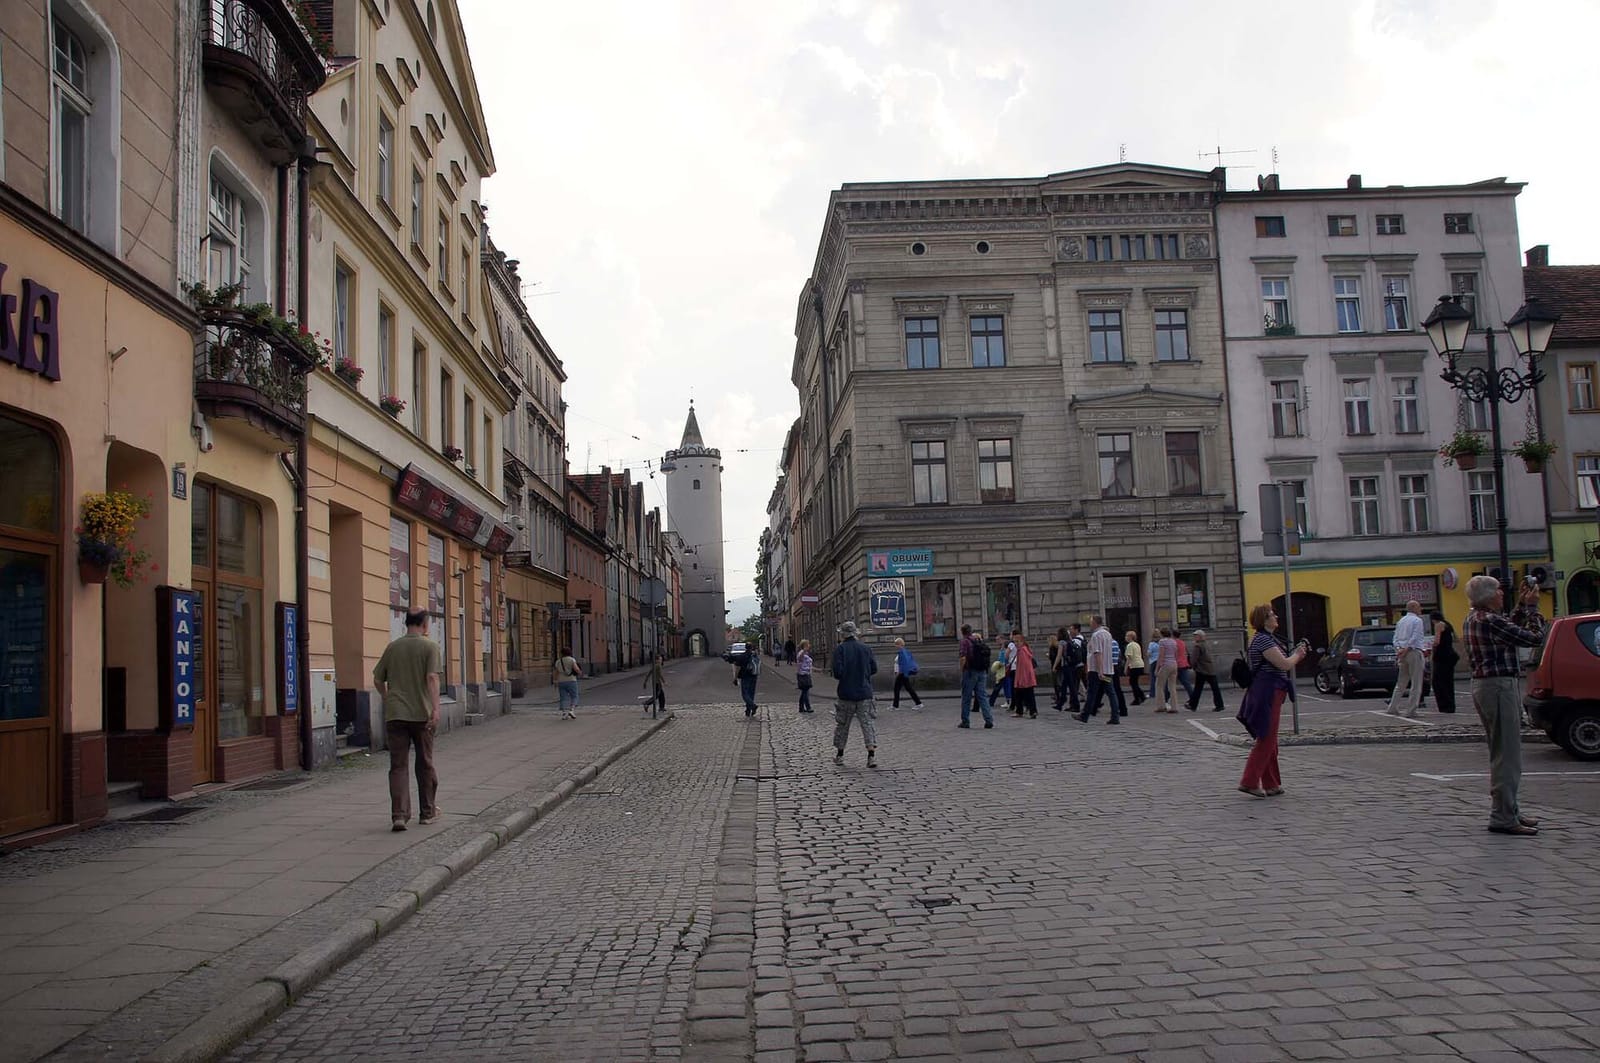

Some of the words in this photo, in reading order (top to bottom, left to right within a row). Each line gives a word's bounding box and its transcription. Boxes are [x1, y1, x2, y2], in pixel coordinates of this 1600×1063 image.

[891, 553, 930, 563] OBUWIE
[176, 598, 191, 718] KANTOR
[286, 611, 295, 697] KANTOR
